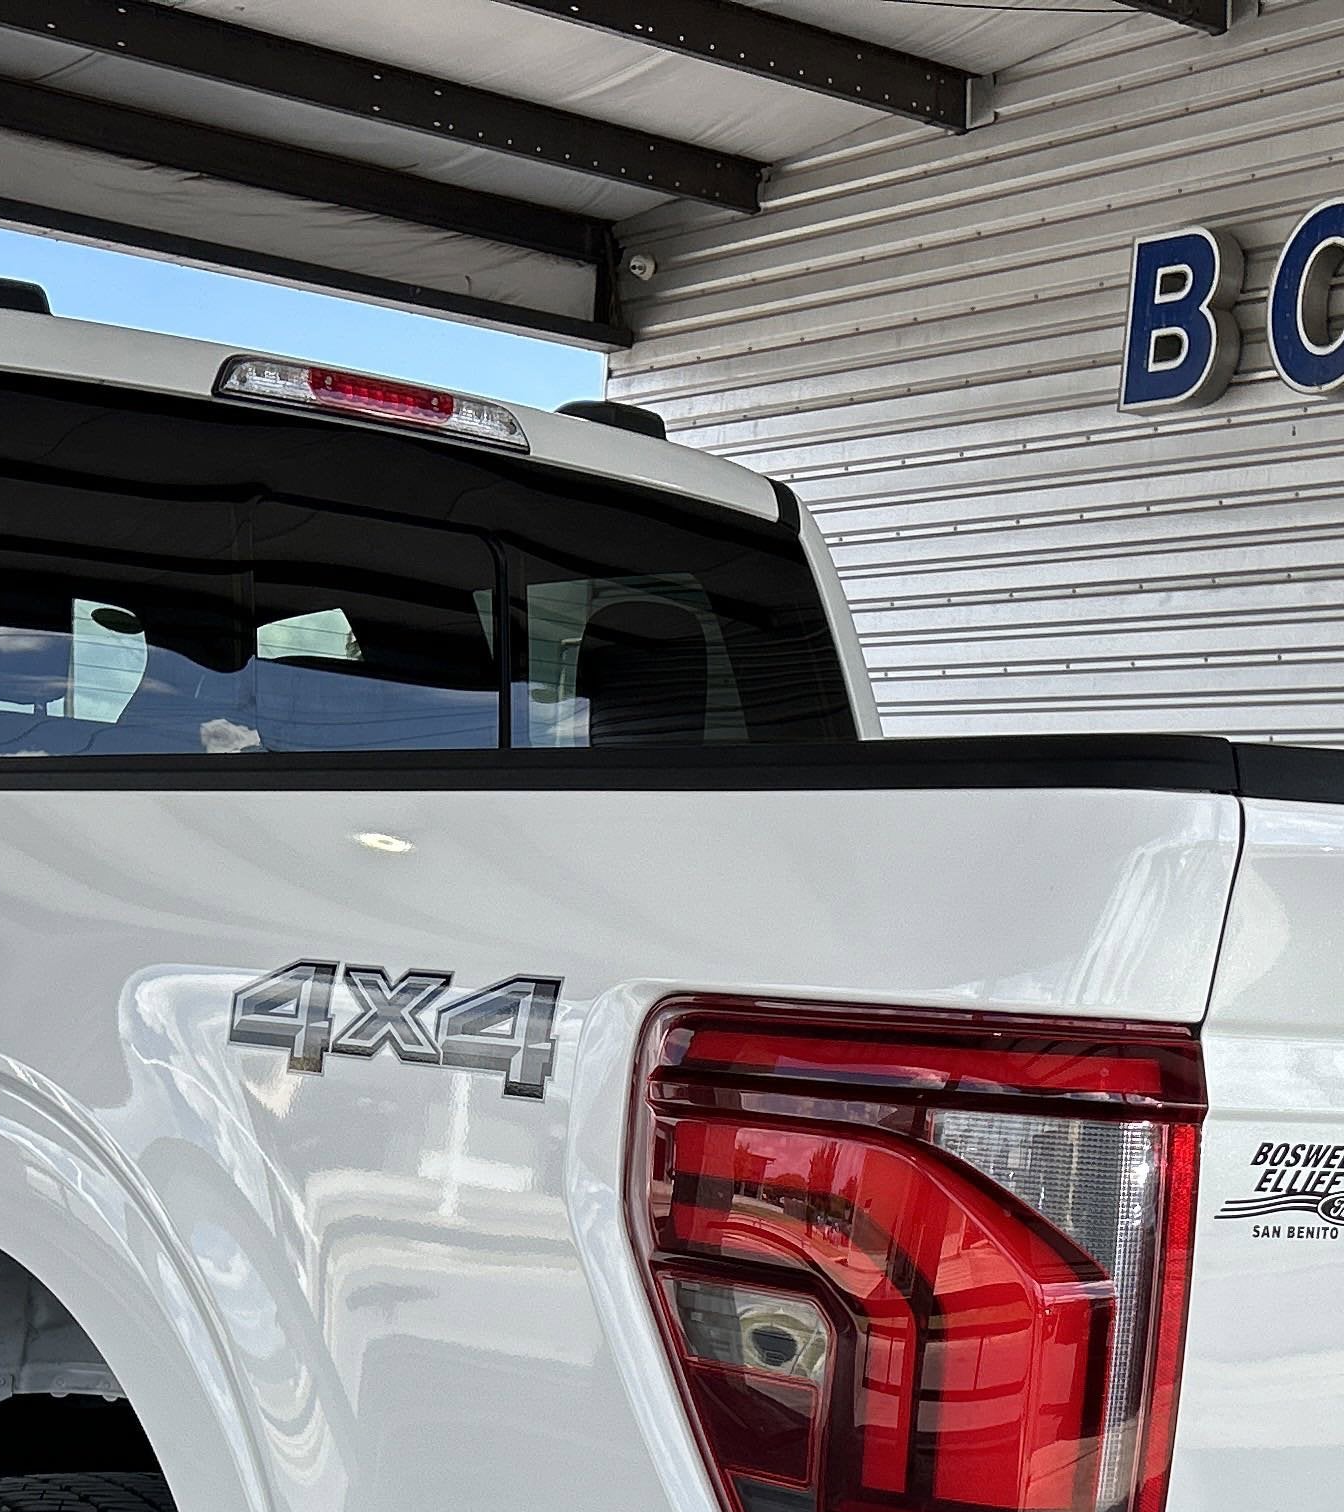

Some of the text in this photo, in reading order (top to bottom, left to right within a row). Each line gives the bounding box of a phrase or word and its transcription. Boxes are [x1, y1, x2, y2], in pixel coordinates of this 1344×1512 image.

[228, 958, 565, 1102] 4X4
[1252, 1224, 1339, 1240] SAN BENITO
